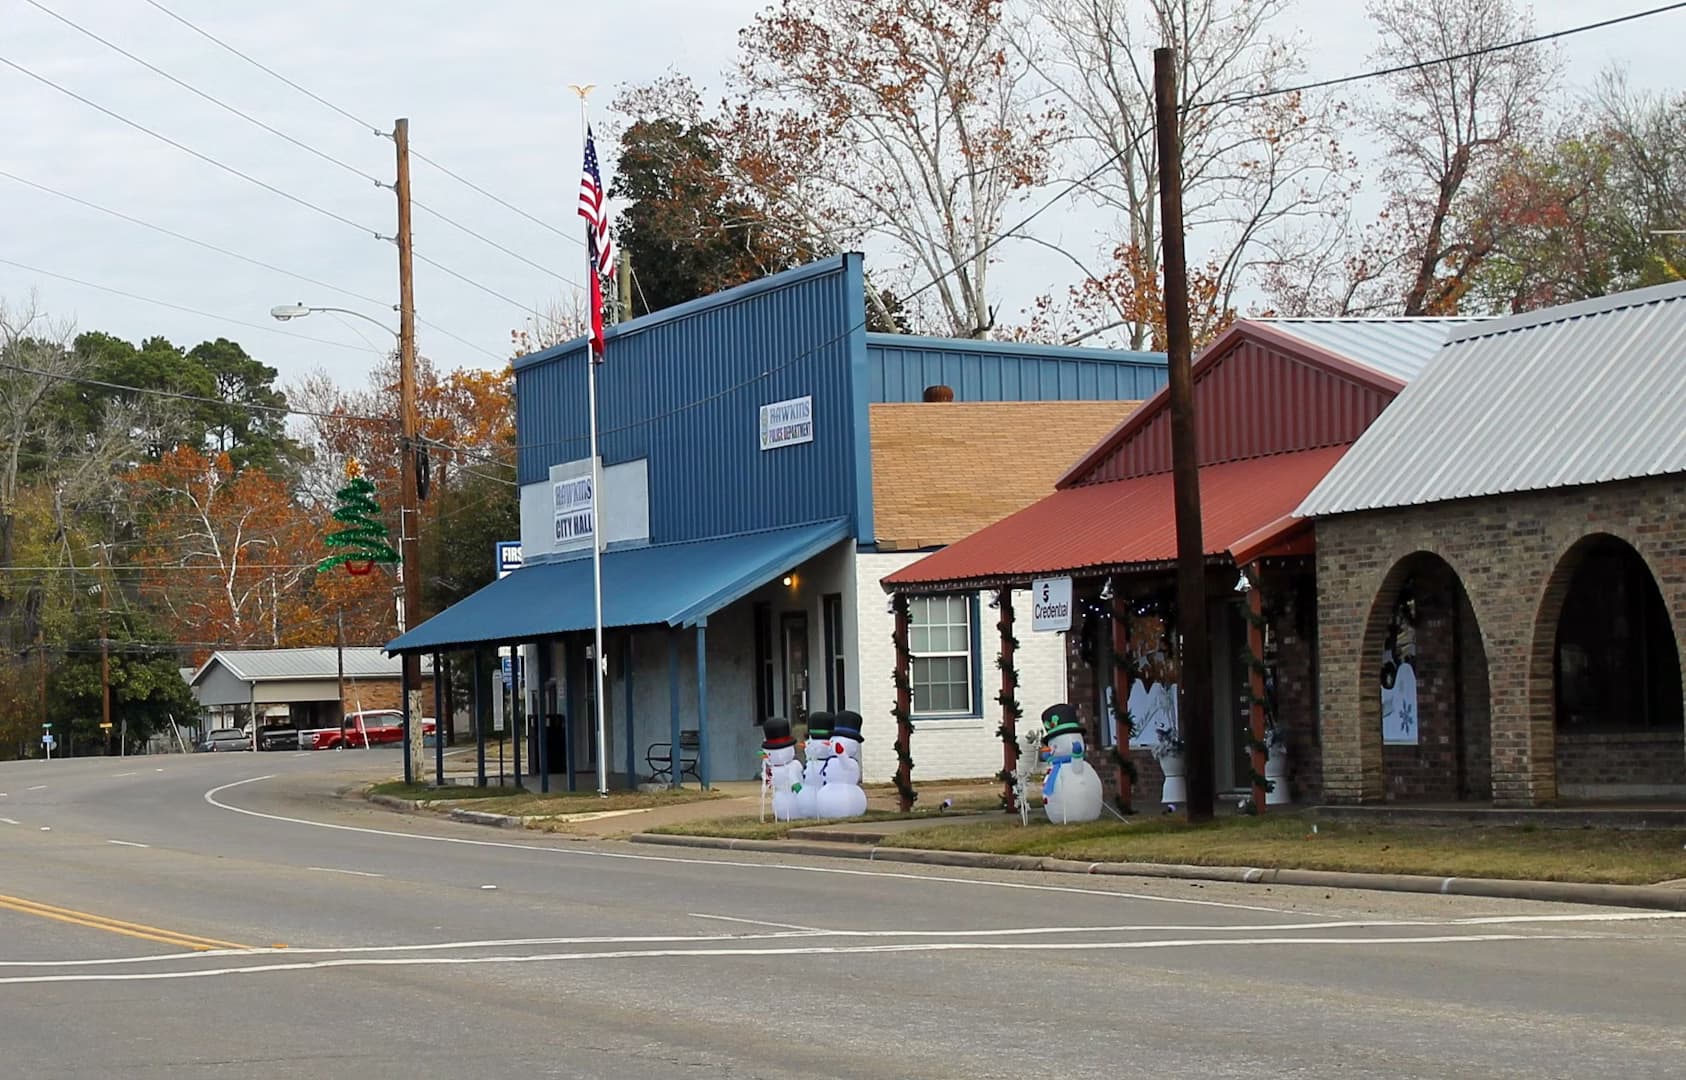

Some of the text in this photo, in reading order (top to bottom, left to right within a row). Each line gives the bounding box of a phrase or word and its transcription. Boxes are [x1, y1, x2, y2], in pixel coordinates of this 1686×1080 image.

[555, 513, 592, 539] CITY HALL
[1035, 601, 1068, 619] Credential
